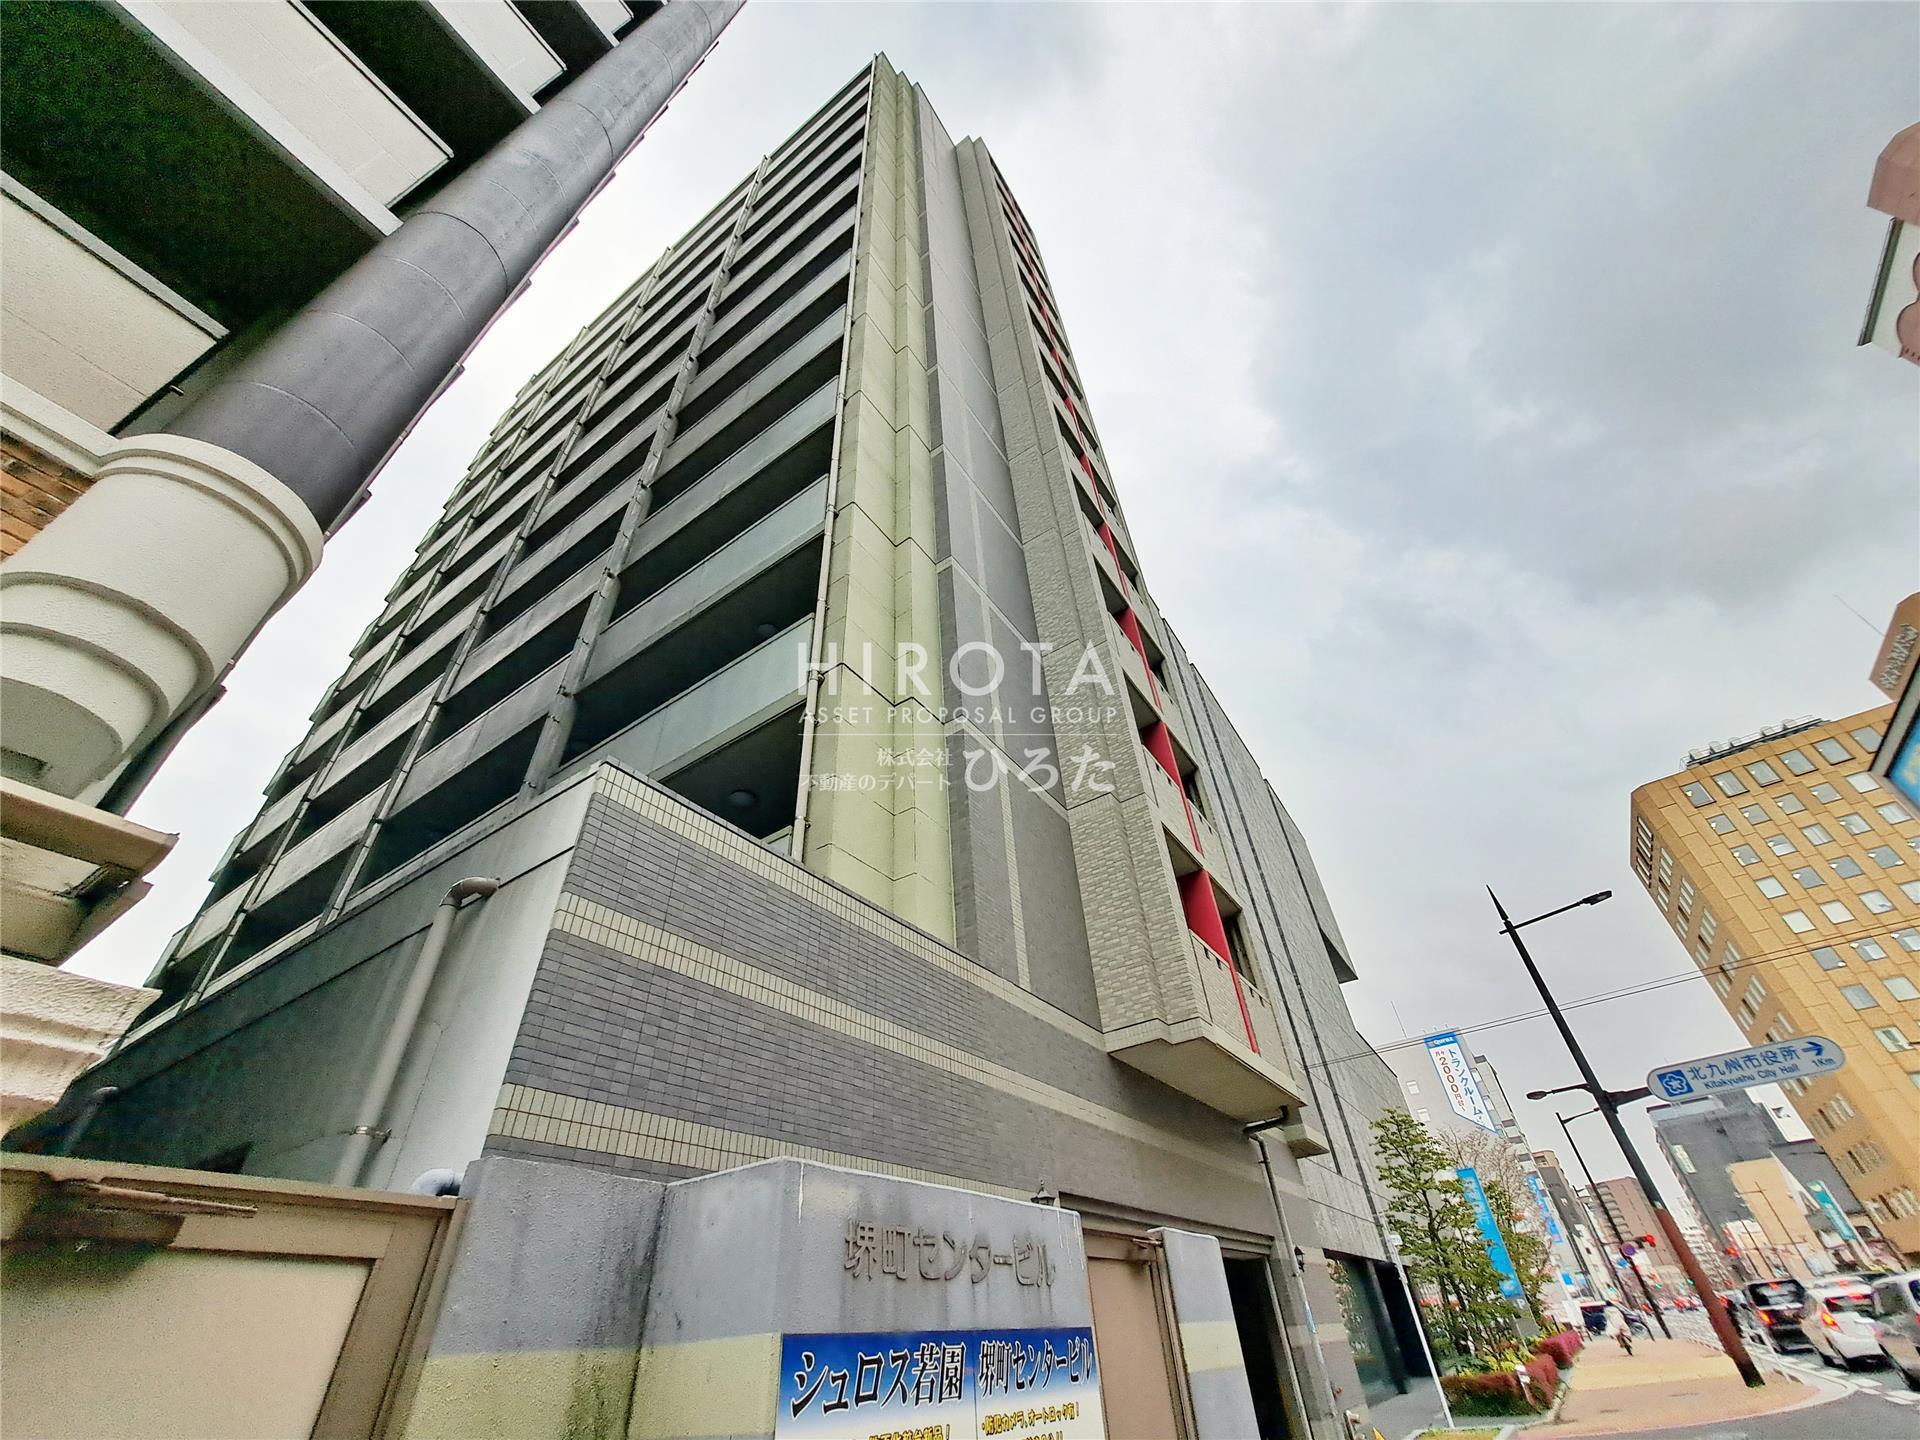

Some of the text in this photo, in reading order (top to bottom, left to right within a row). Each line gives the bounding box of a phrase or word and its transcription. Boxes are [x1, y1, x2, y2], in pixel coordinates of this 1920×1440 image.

[1448, 1048, 1483, 1116] トランクルーム
[1687, 1046, 1800, 1081] 北九州市役所
[1704, 1063, 1800, 1090] Kitakyushu City Hall
[843, 1219, 1056, 1287] 堺町センタービル
[791, 1341, 966, 1421] シュロス若園
[979, 1337, 1093, 1397] 堺町センタービル
